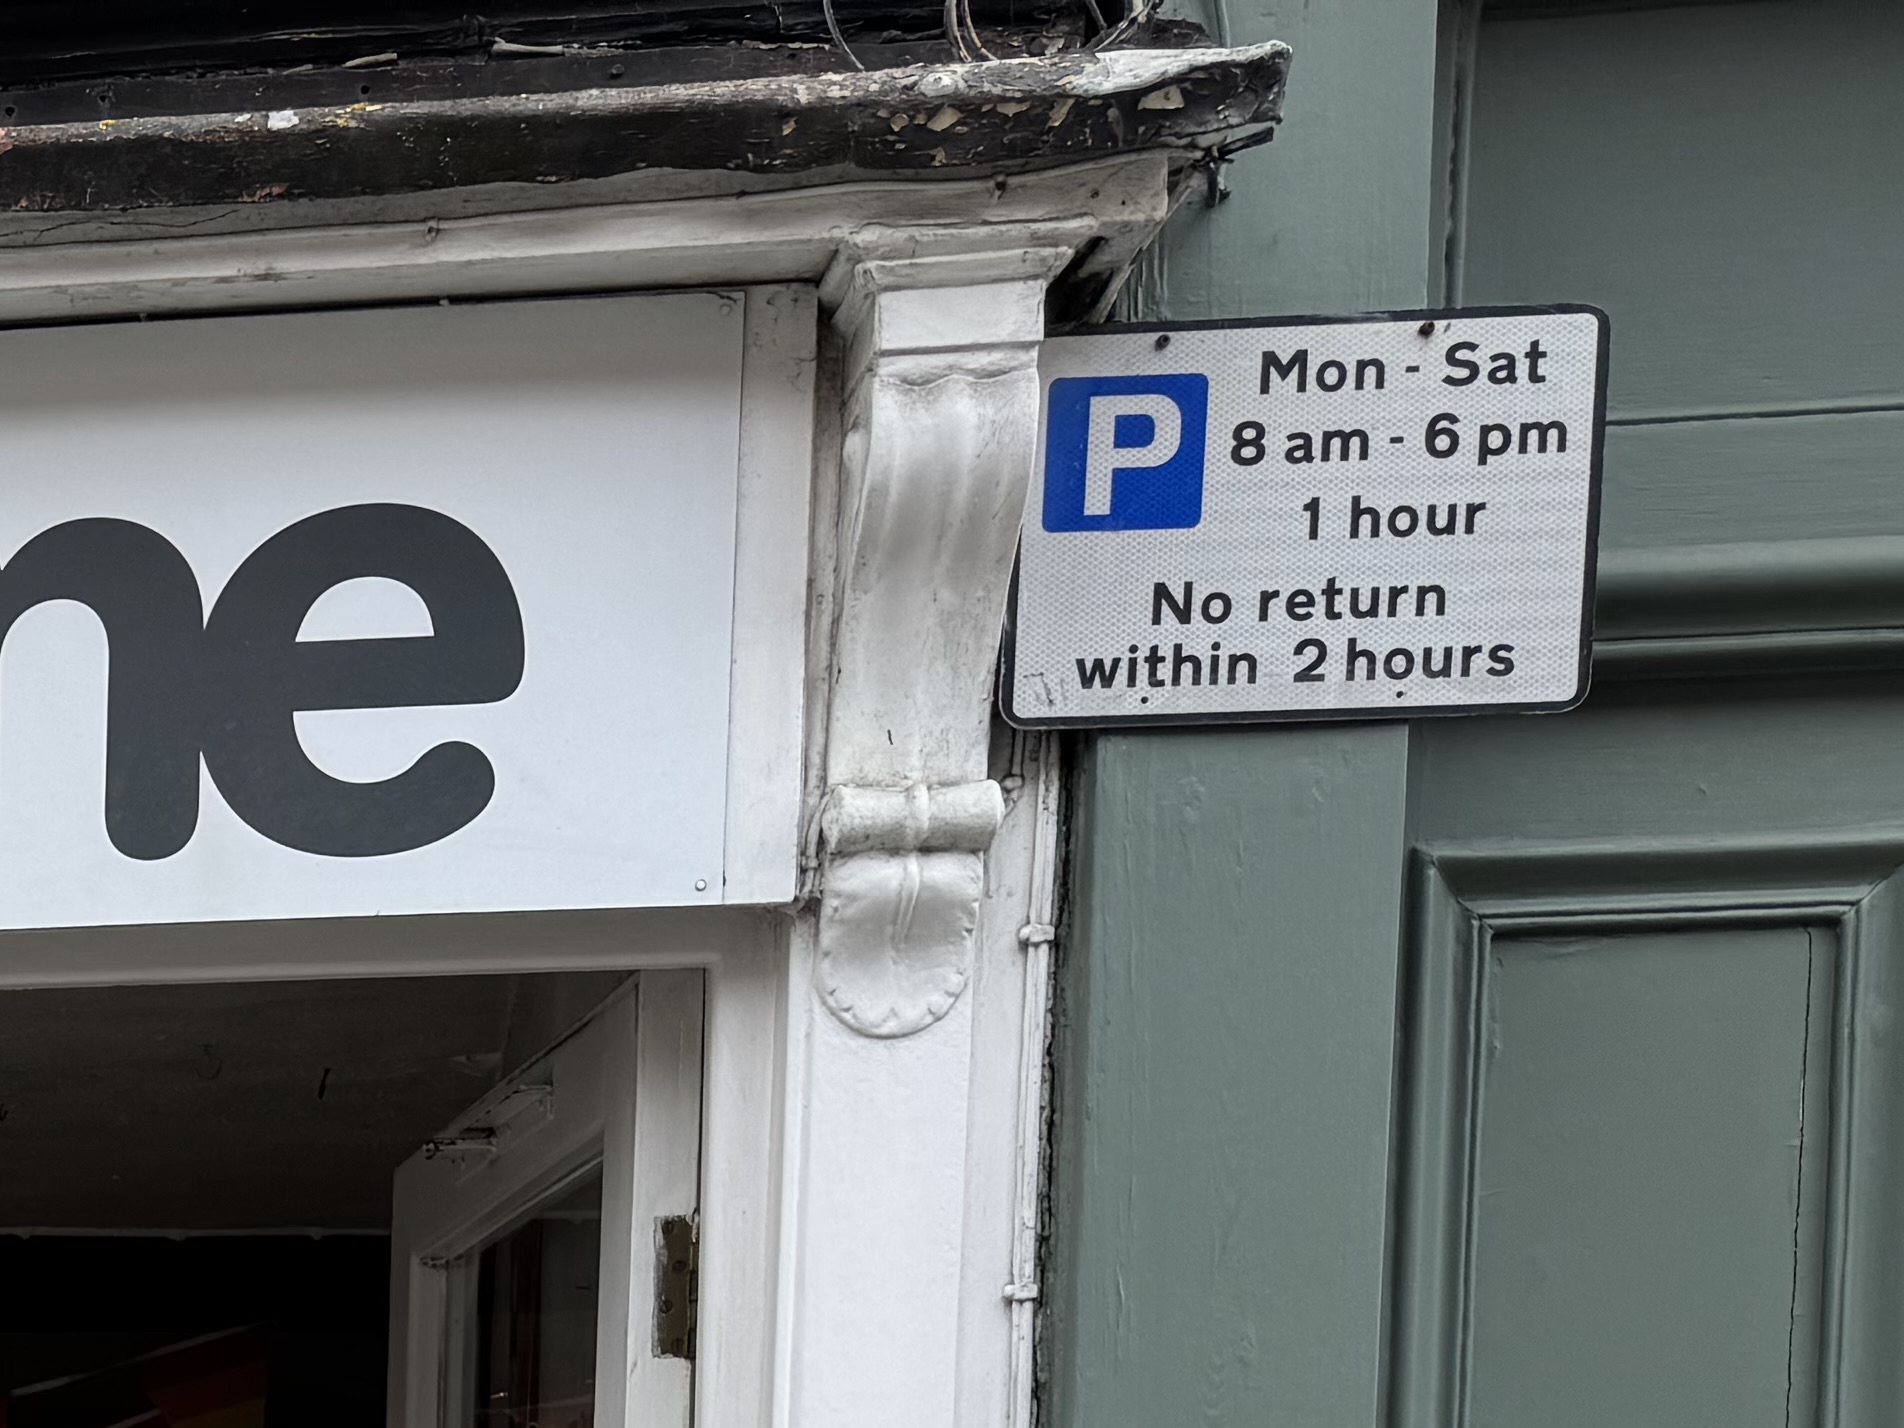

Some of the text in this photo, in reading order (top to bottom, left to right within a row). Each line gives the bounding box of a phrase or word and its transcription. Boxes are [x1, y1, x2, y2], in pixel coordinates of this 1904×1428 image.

[1260, 349, 1385, 395] Mon
[1443, 338, 1548, 387] Sat
[1084, 394, 1182, 516] P
[1302, 497, 1488, 540] 1 hour
[1152, 578, 1447, 626] No return
[1075, 637, 1517, 690] within 2 hours
